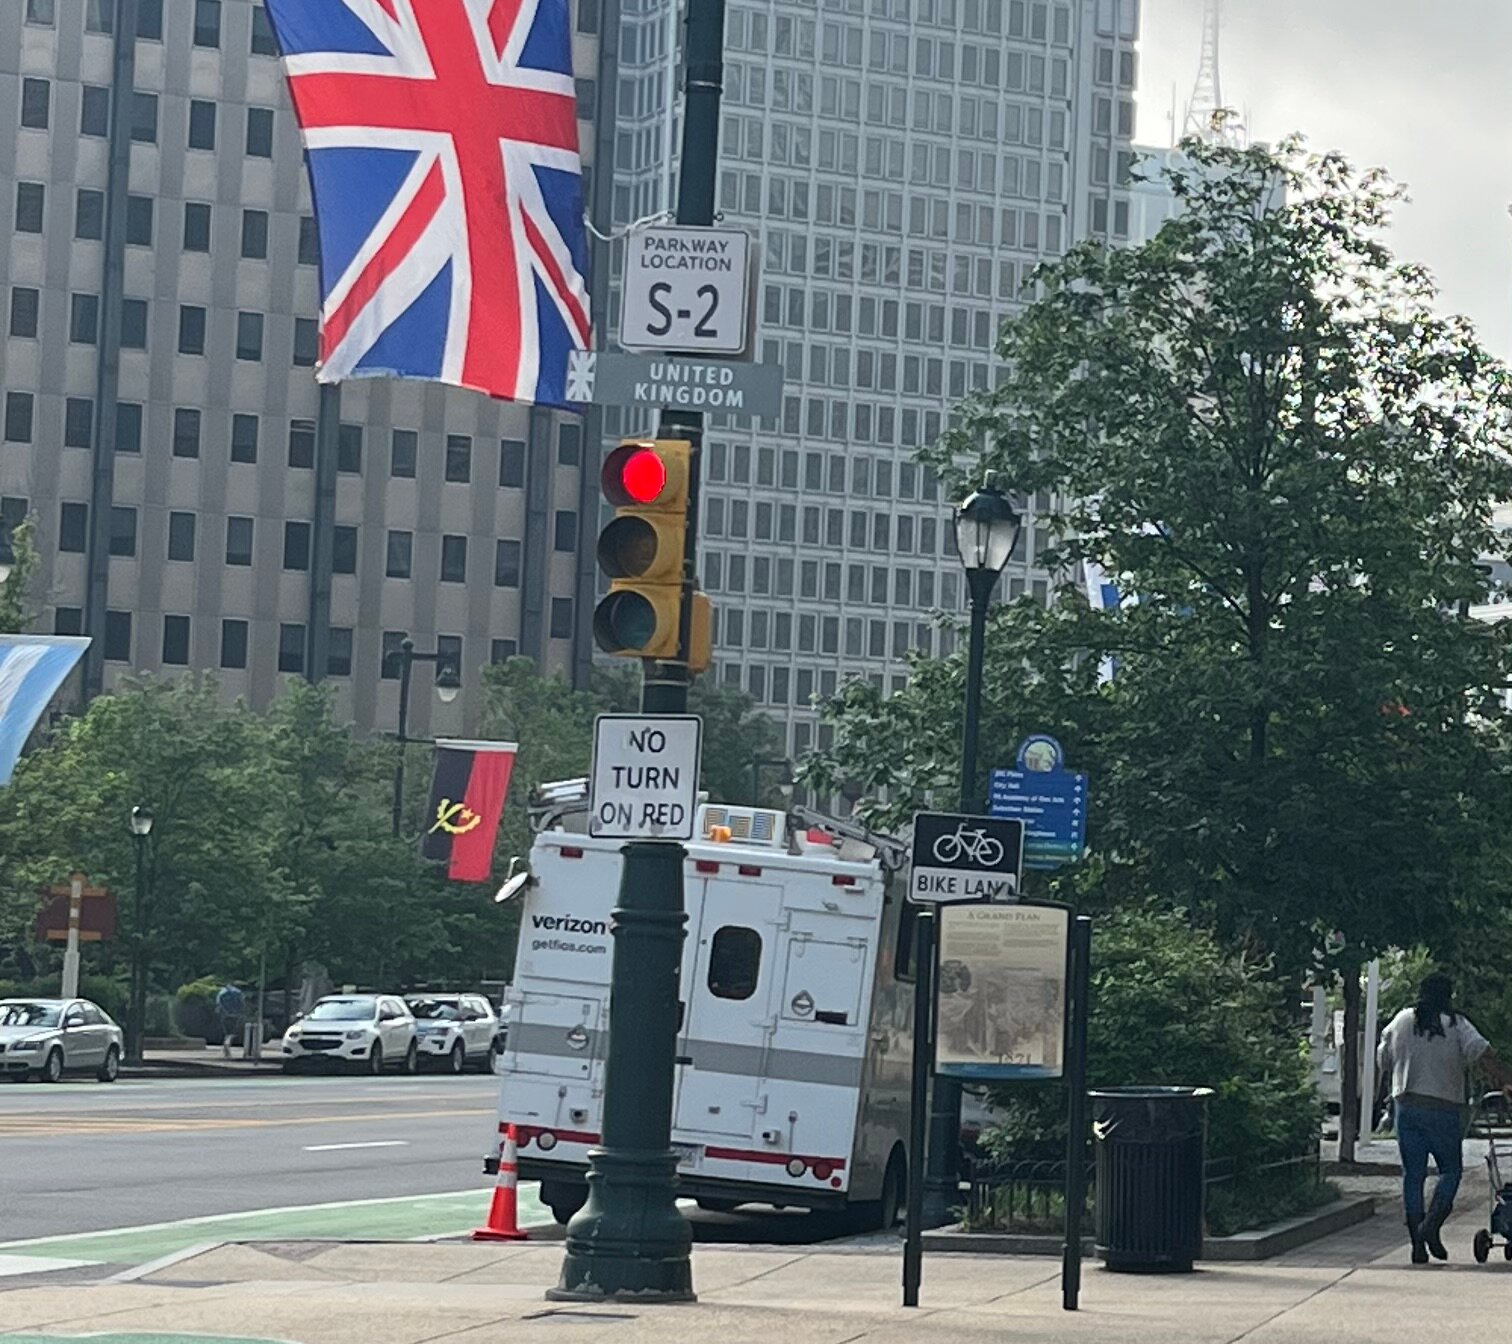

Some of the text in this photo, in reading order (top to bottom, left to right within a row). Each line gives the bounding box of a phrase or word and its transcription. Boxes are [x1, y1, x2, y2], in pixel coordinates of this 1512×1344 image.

[644, 237, 729, 254] PARKWAY
[641, 254, 732, 271] LOCATION
[646, 282, 719, 338] S-2
[650, 363, 734, 385] UNITED
[634, 383, 744, 408] KINGDOM
[630, 729, 666, 753] NO
[612, 766, 679, 790] TURN
[600, 802, 684, 826] ON RED
[917, 874, 957, 893] BIKE
[532, 913, 606, 935] verizon
